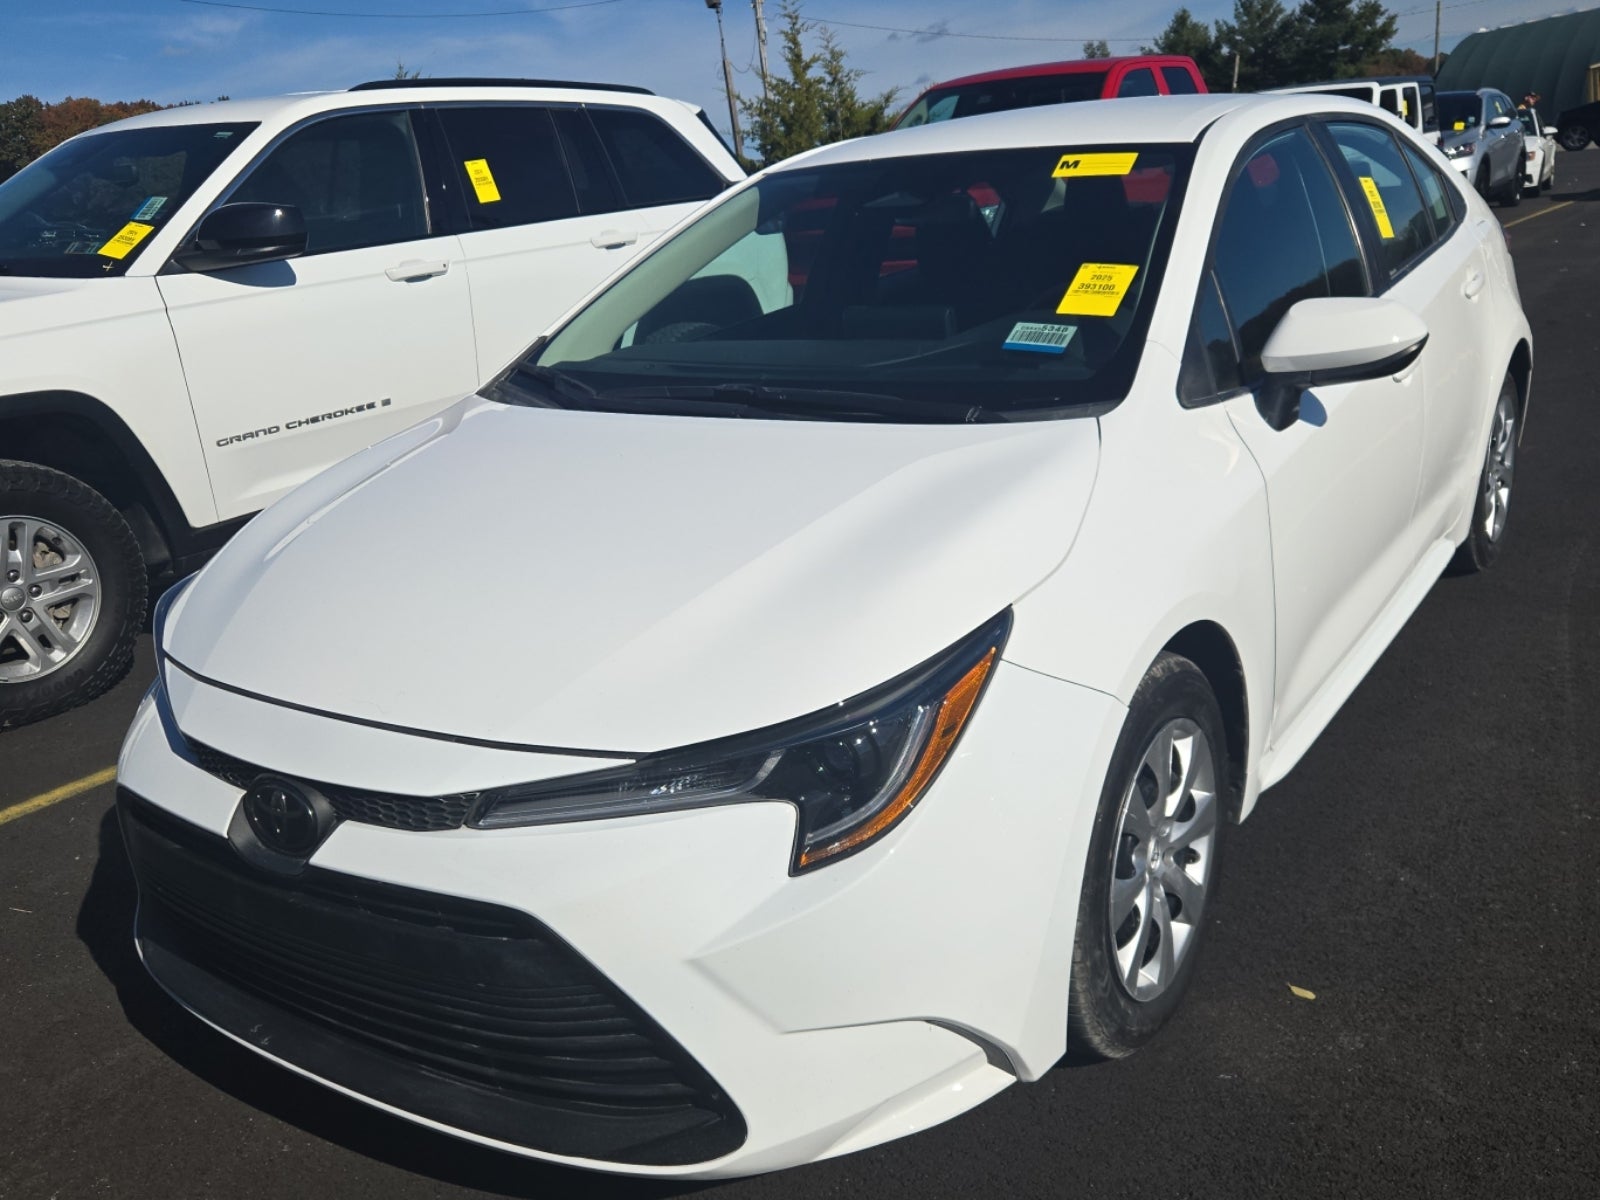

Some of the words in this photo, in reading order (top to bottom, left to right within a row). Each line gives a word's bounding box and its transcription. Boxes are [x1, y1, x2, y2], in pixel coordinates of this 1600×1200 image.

[1059, 159, 1081, 169] M
[1077, 282, 1116, 291] 393100
[215, 425, 280, 447] GRAND
[285, 401, 377, 430] CHEROKEE
